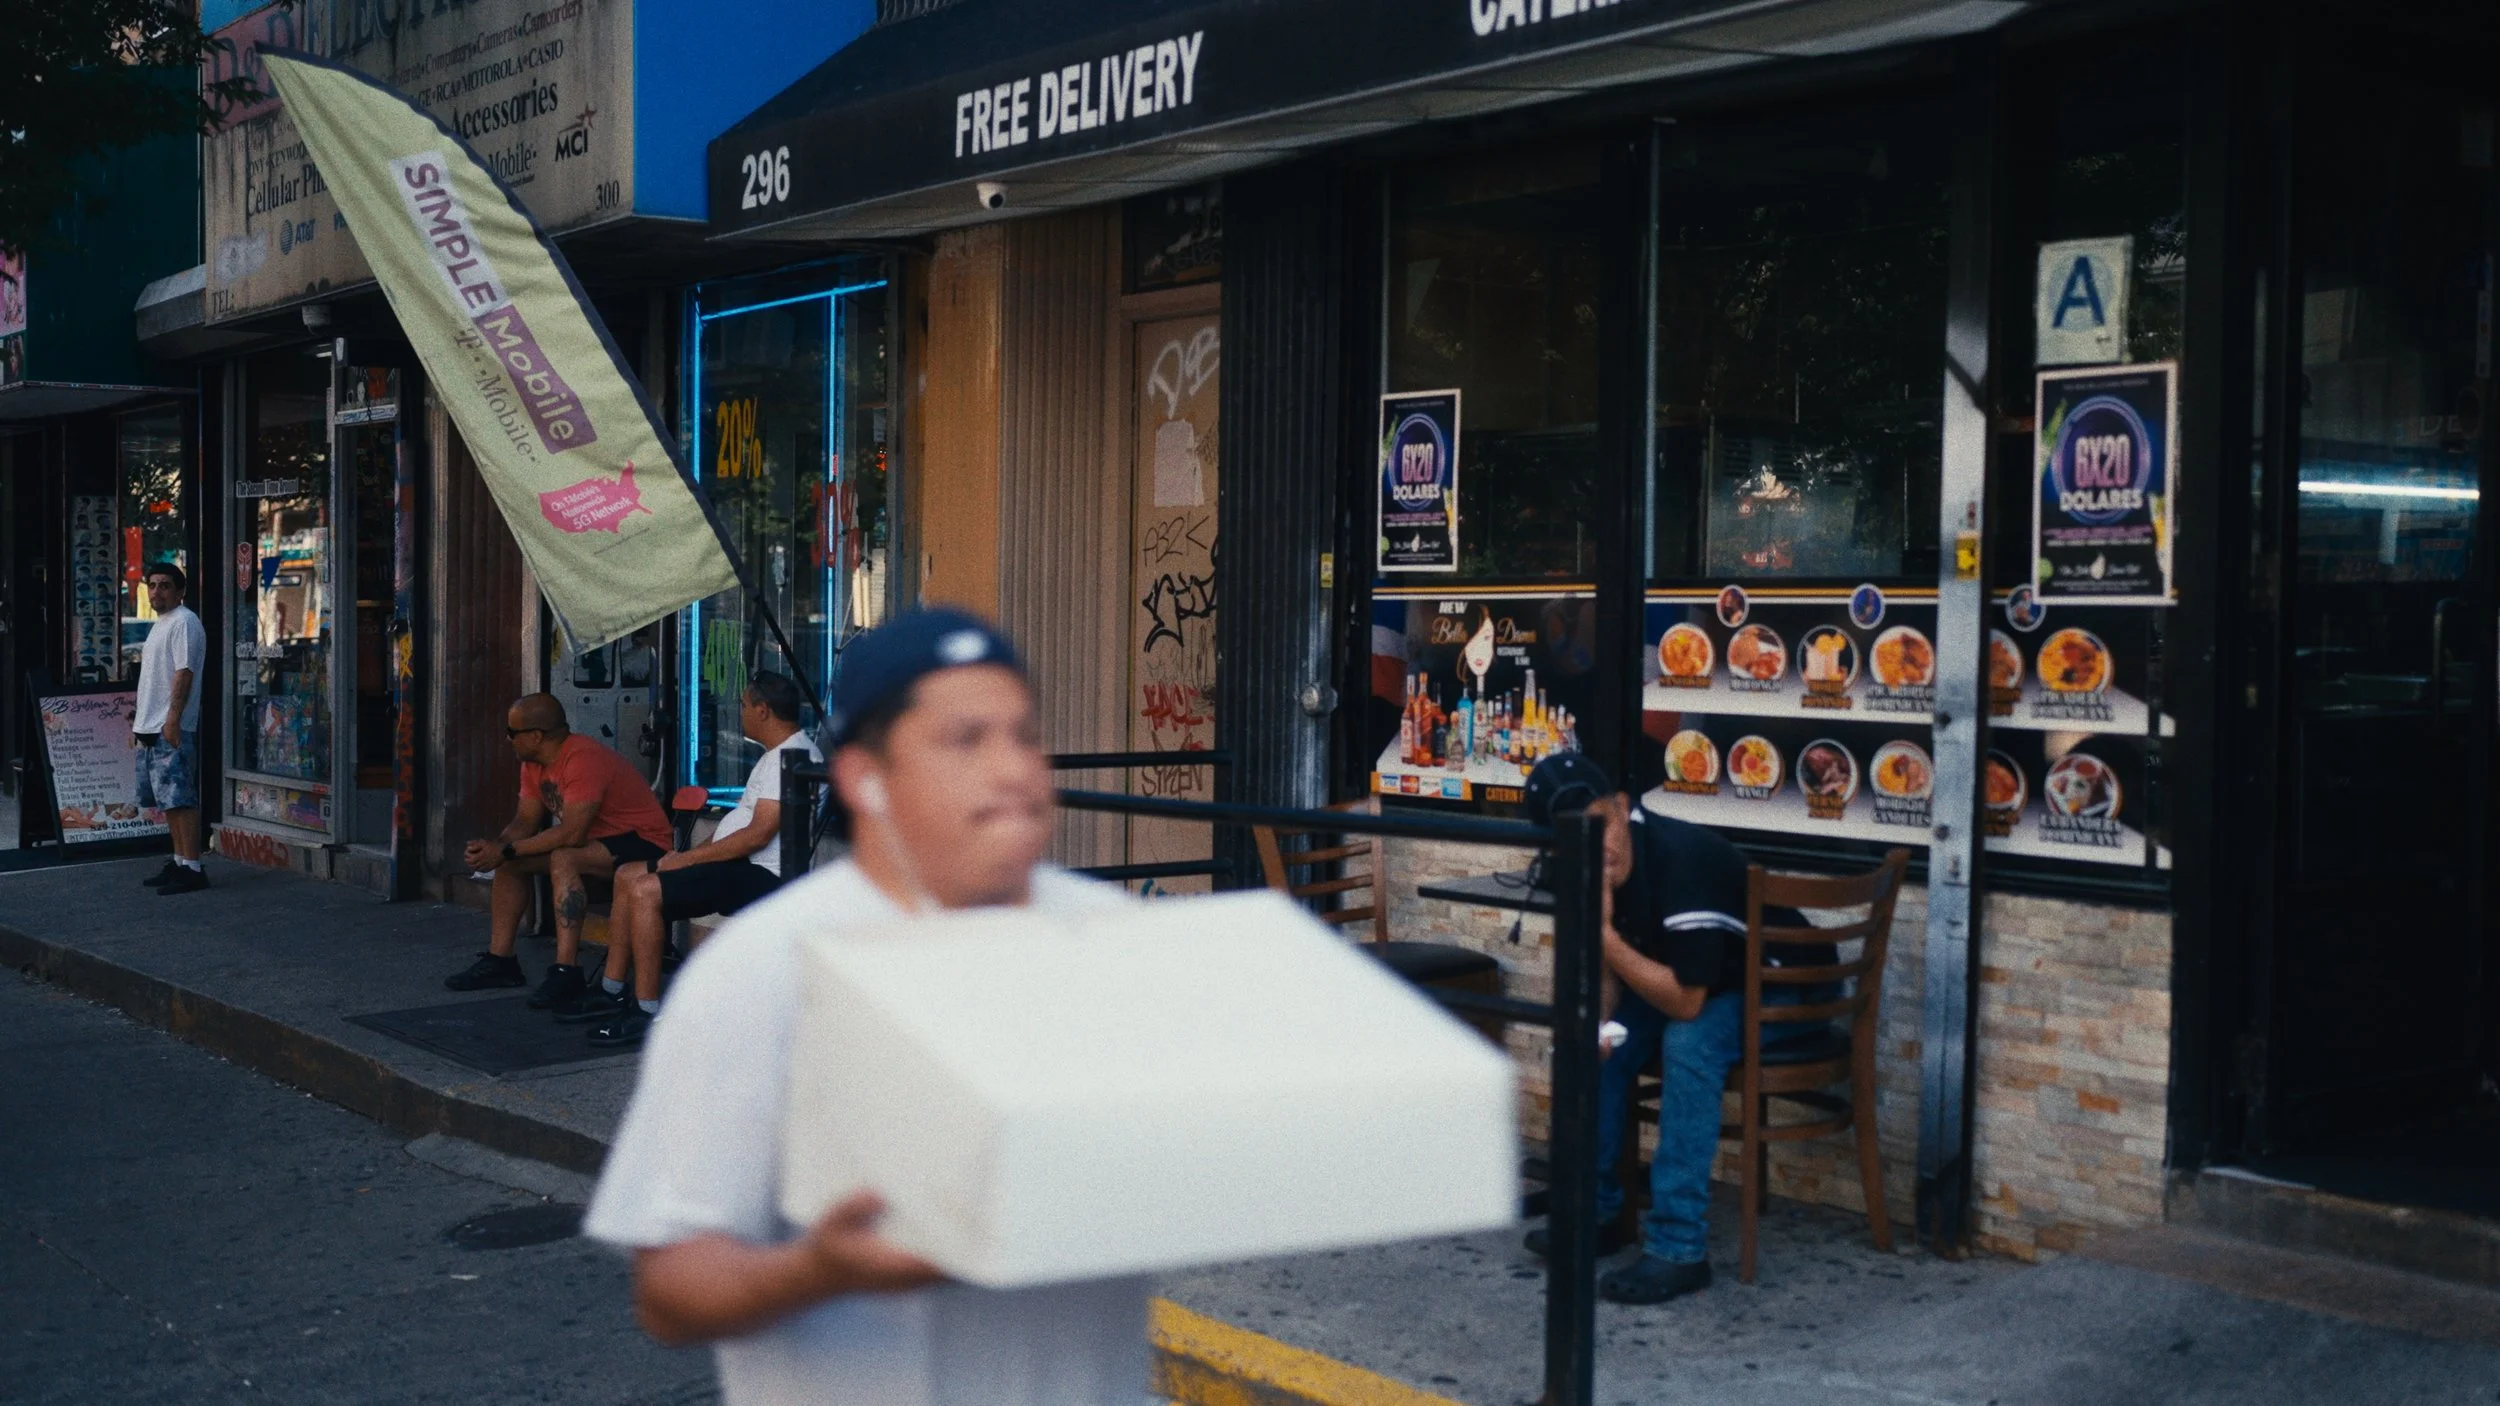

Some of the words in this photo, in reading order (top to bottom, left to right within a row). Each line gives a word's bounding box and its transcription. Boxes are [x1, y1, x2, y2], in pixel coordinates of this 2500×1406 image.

[462, 56, 523, 95] MOTOROLA
[528, 38, 563, 68] CASIO
[955, 77, 1031, 158] FREE
[1038, 30, 1205, 140] DELIVERY
[451, 76, 558, 140] Accessories
[555, 129, 589, 162] MCI
[248, 174, 300, 218] Cellular
[596, 180, 620, 211] 300
[741, 145, 791, 211] 296
[404, 163, 498, 310] SIMPLE
[2053, 256, 2104, 328] A
[484, 315, 575, 441] Mobile
[716, 396, 764, 480] 20%
[573, 514, 592, 530] 5G
[590, 497, 634, 521] Network
[1392, 483, 1441, 501] DOLARES
[2059, 488, 2144, 513] DOLARES
[1438, 601, 1468, 615] NEW
